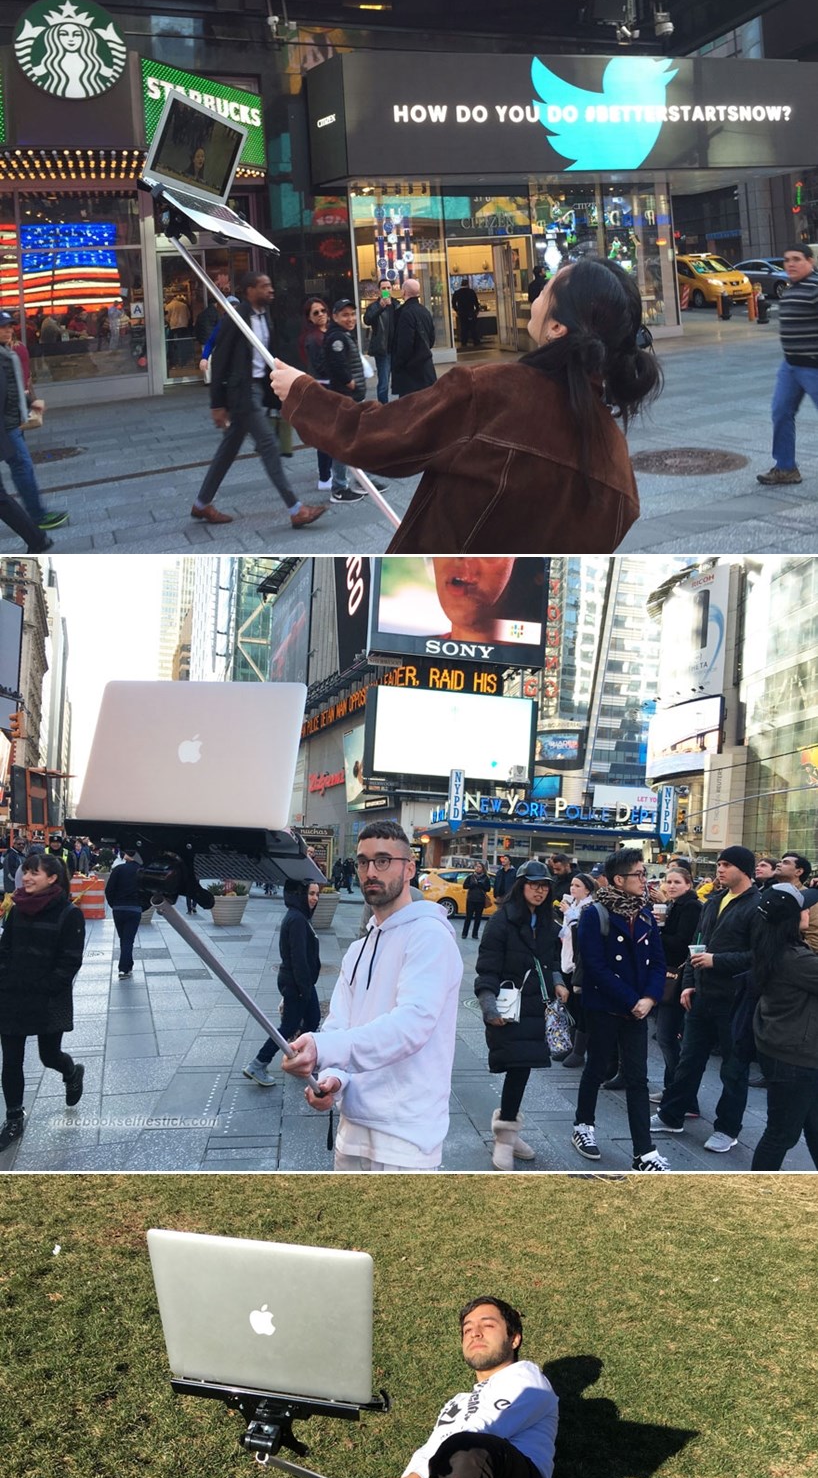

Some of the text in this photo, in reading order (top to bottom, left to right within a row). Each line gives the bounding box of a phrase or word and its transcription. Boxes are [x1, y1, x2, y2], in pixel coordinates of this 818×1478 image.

[394, 105, 792, 123] HOW DO YOU DO #BETTERSTARTSNOW?
[692, 574, 715, 588] RICOH
[425, 639, 495, 659] SONY
[429, 668, 465, 691] RAID
[474, 673, 498, 694] HIS
[453, 774, 463, 819] NYPD
[465, 791, 501, 814] NEW
[507, 793, 548, 817] YORK
[555, 797, 611, 822] POLICE
[662, 788, 672, 833] NYPD
